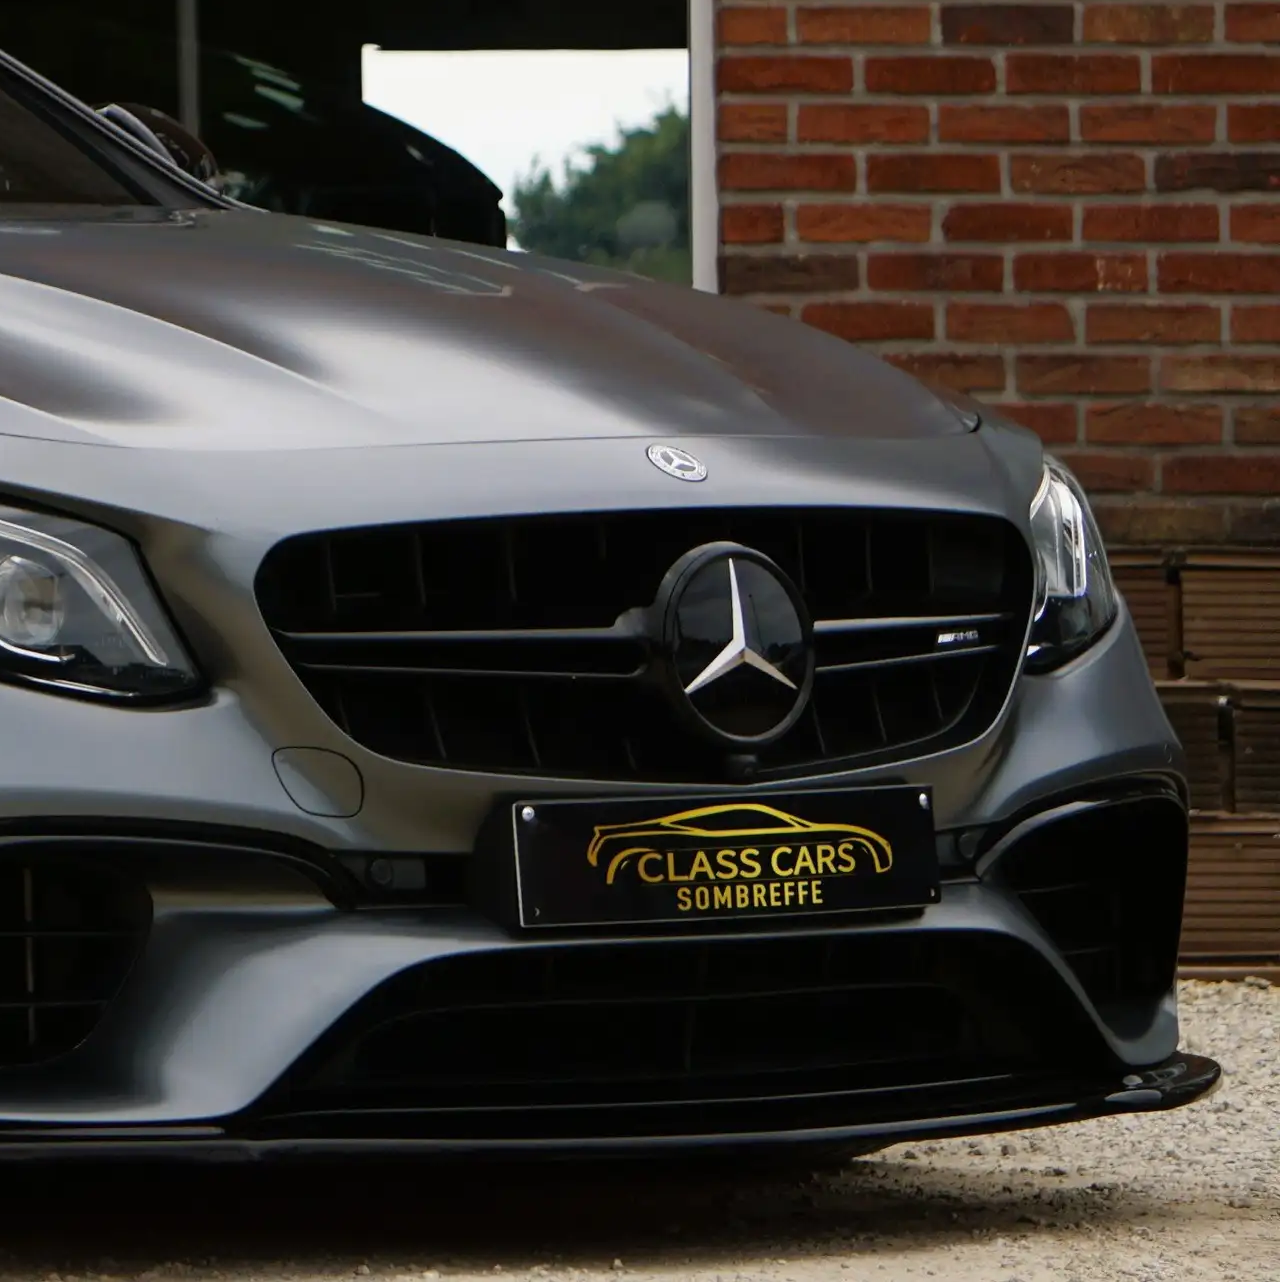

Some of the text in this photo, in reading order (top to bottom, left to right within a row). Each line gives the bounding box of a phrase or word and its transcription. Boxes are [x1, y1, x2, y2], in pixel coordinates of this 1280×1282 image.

[637, 843, 857, 883] CLASS CARS
[677, 880, 823, 911] SOMBREFFE
